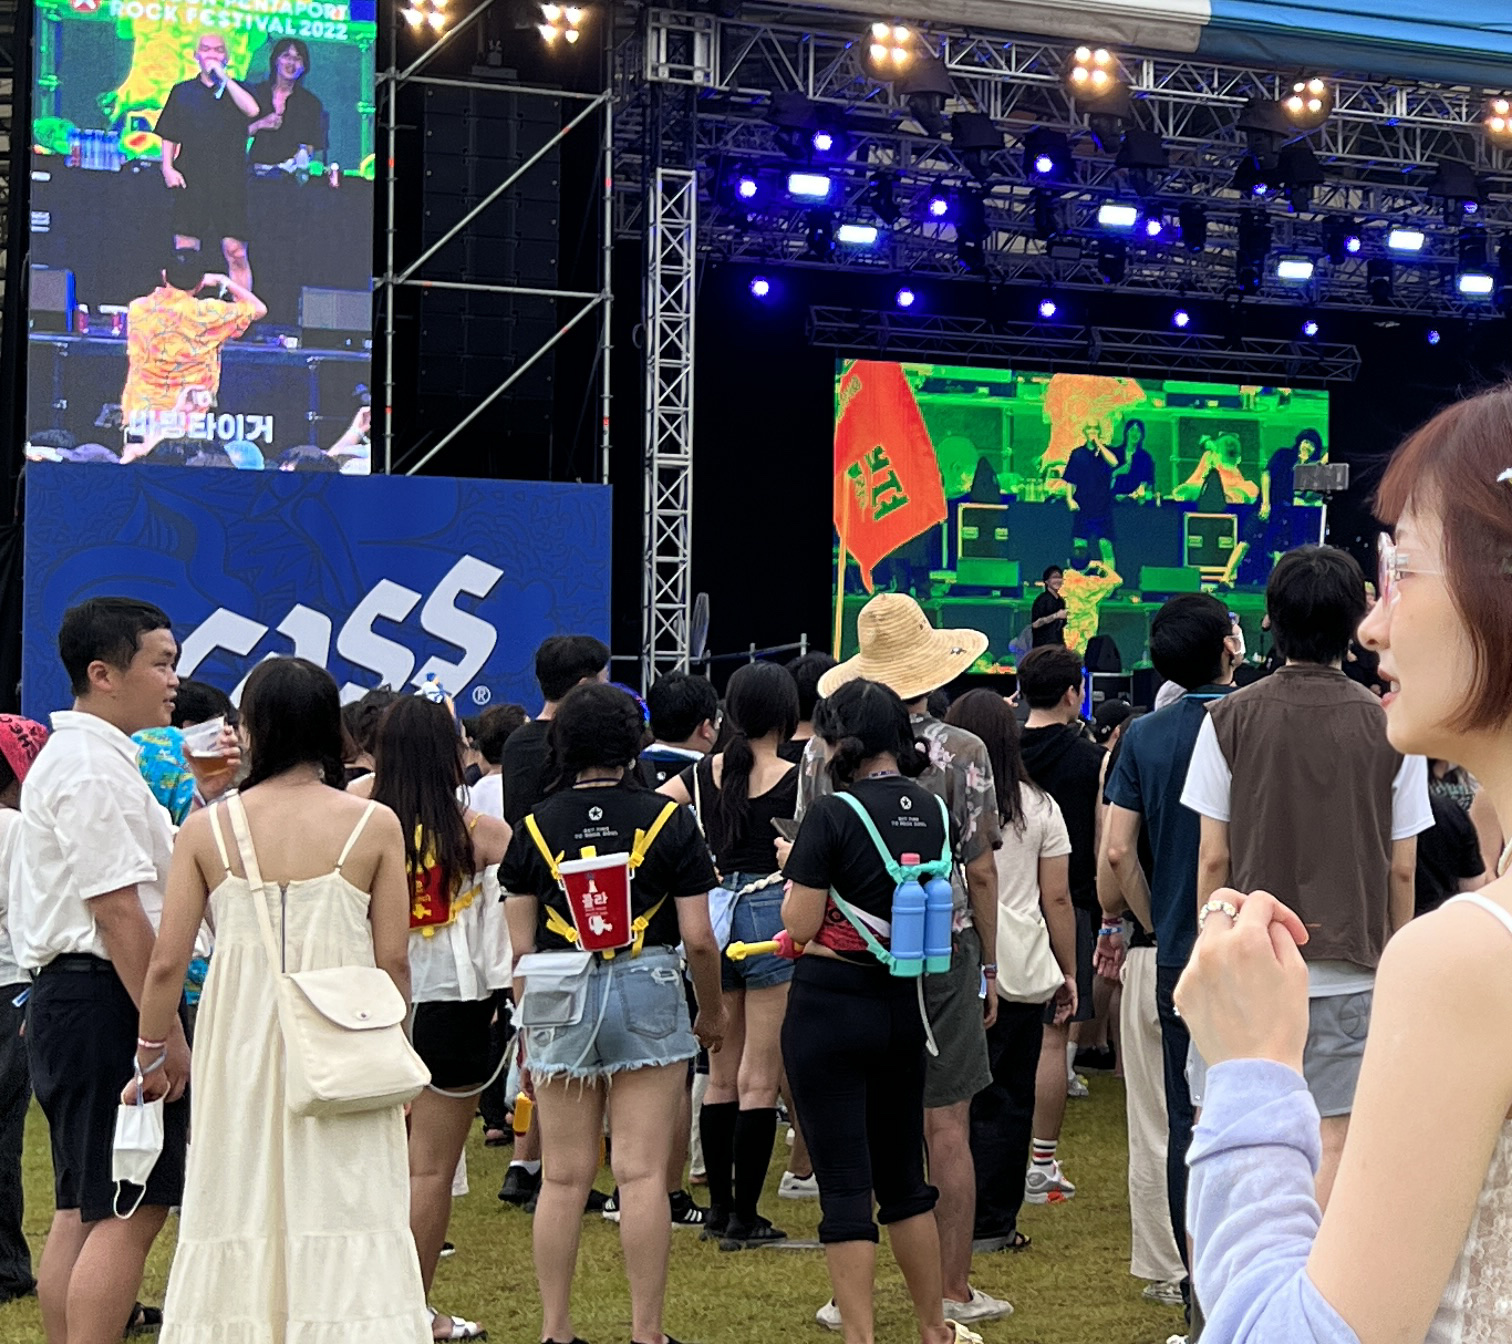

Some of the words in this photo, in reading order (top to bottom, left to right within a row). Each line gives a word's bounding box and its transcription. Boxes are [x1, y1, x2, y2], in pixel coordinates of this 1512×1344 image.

[110, 0, 179, 22] ROCK
[186, 7, 297, 36] FESTIVAL
[299, 20, 350, 41] 2022
